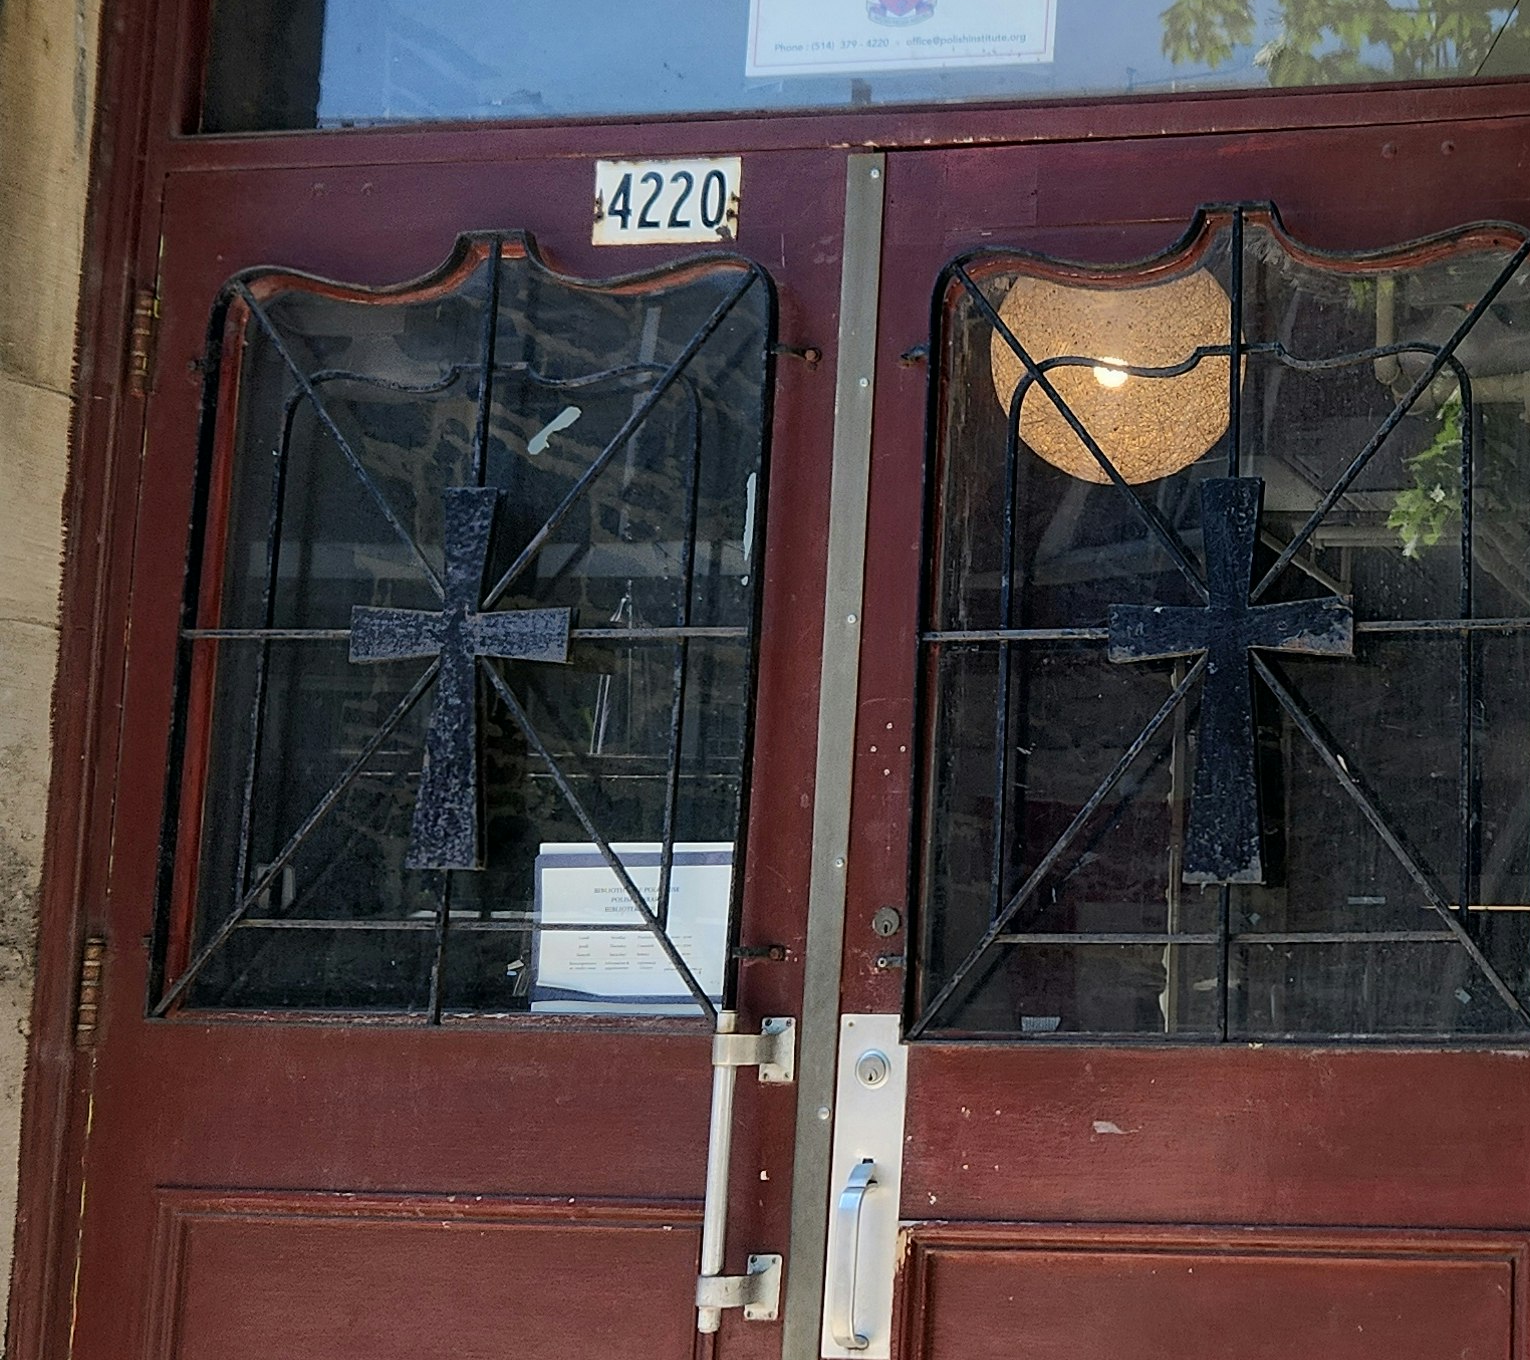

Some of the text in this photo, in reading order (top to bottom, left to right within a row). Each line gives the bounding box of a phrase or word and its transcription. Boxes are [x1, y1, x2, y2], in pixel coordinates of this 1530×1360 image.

[775, 41, 804, 52] Phone
[811, 40, 835, 51] (514)
[840, 39, 858, 49] 379
[867, 38, 890, 48] 4220
[906, 33, 1026, 48] office@polishinstitute.org
[608, 169, 727, 230] 4220
